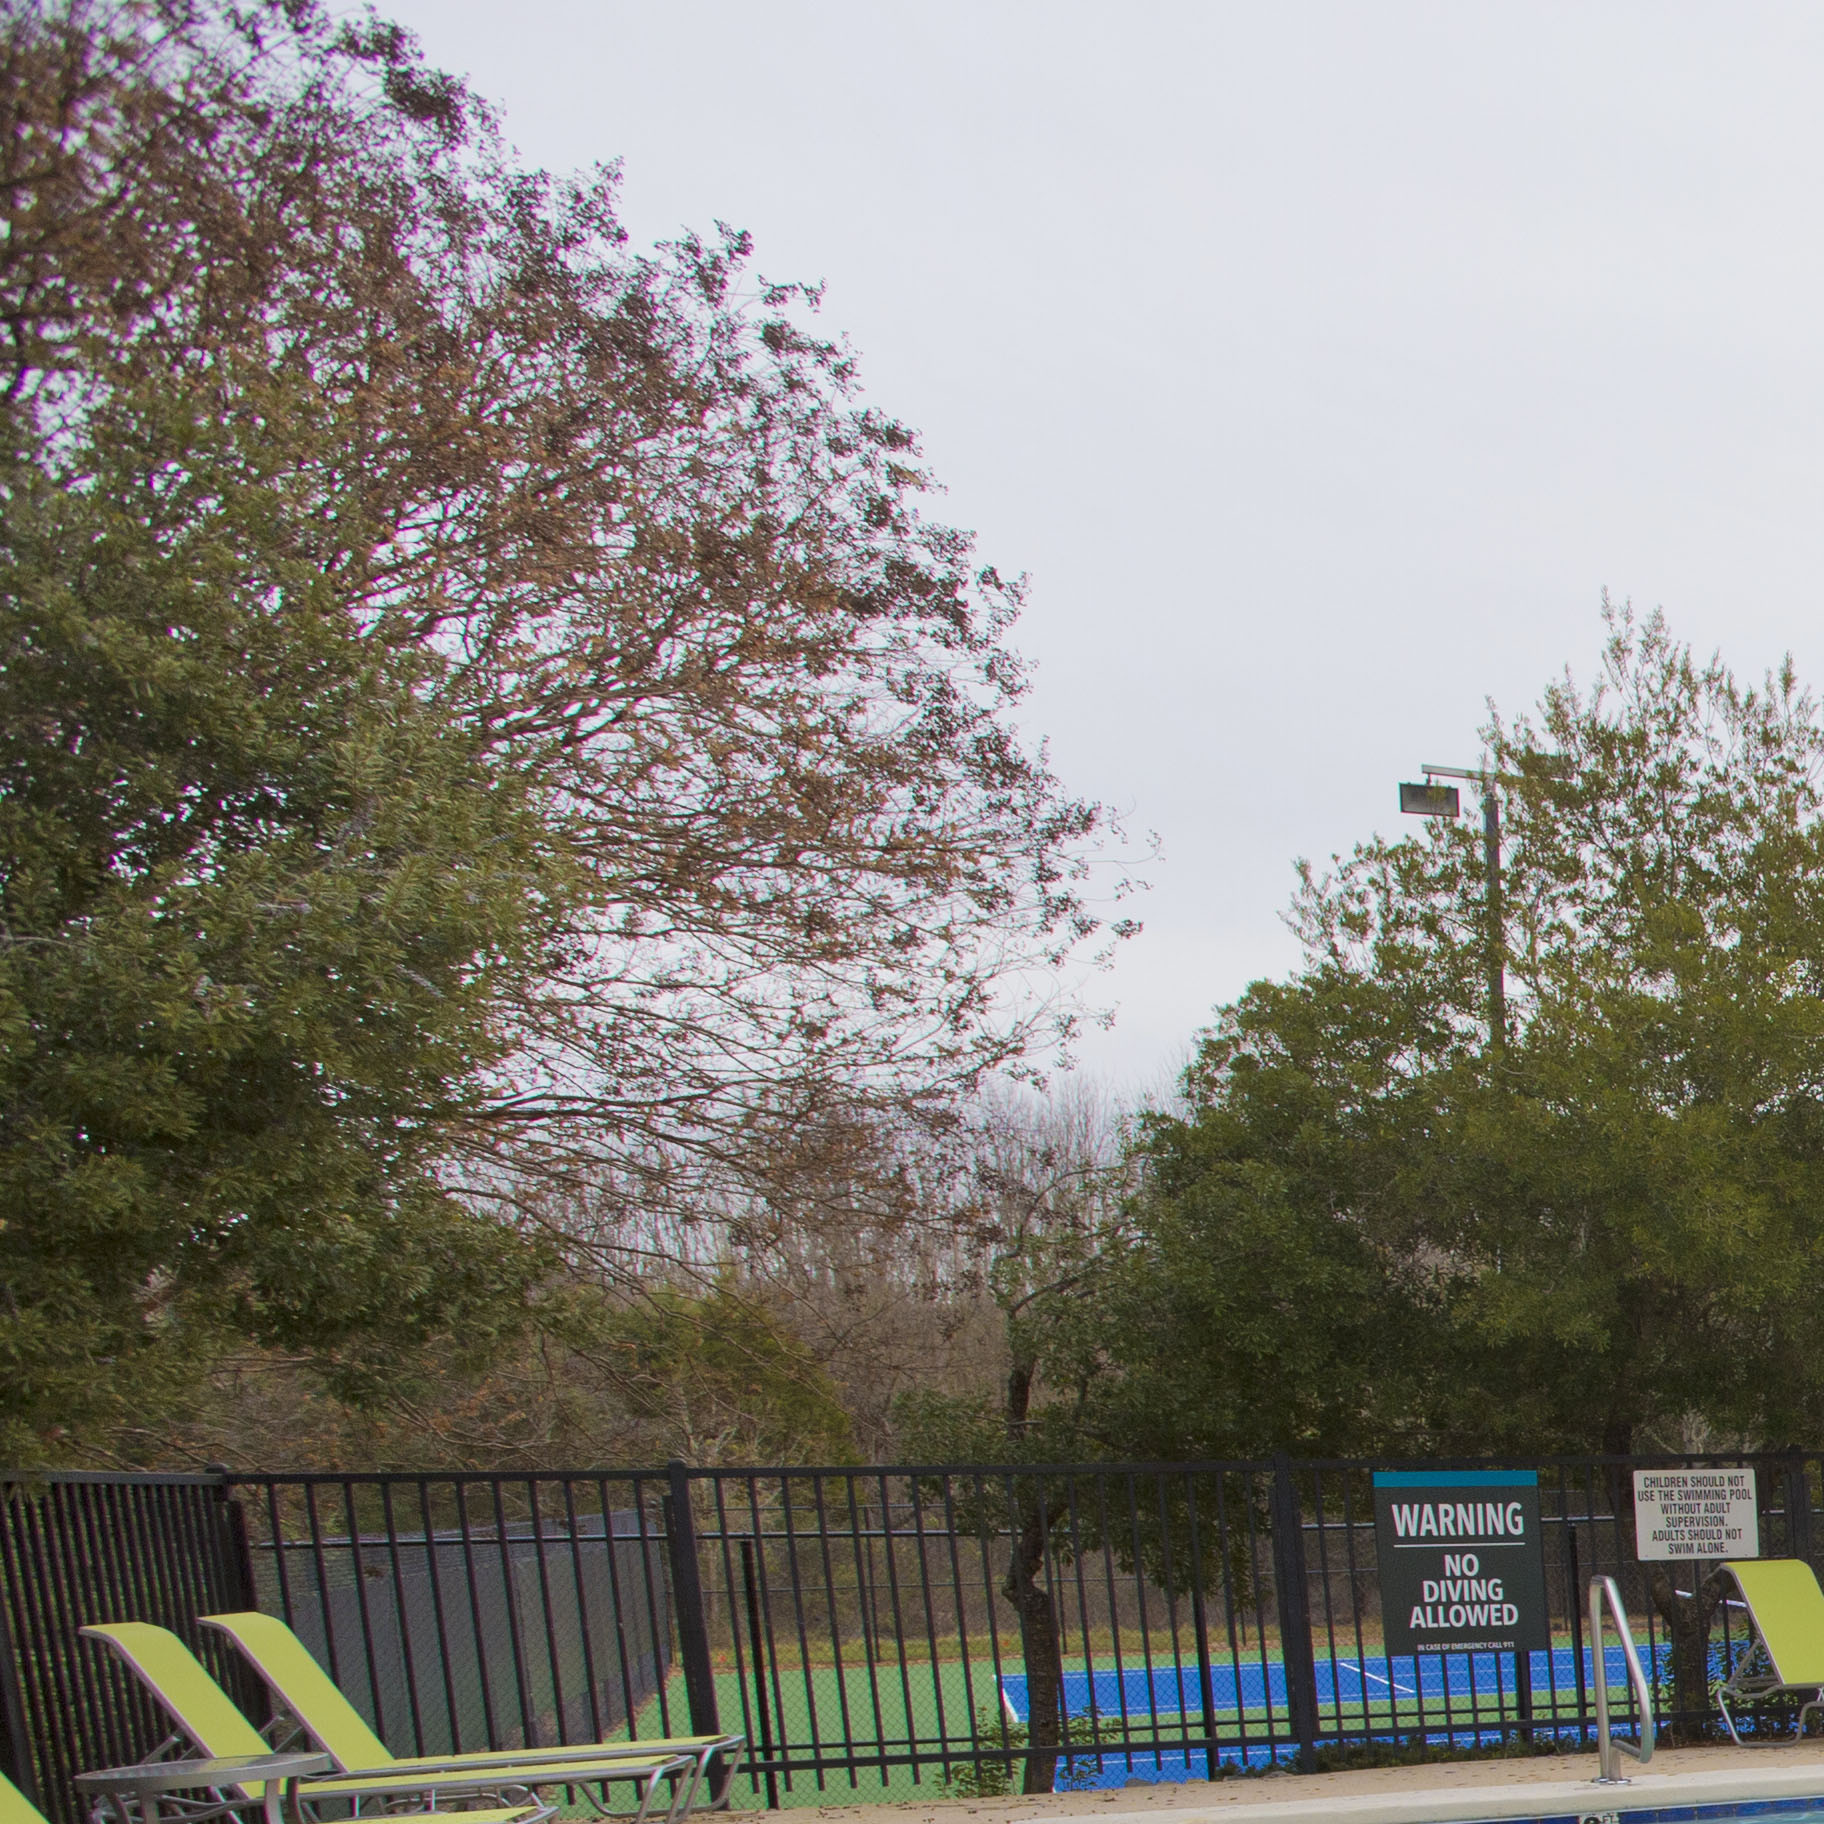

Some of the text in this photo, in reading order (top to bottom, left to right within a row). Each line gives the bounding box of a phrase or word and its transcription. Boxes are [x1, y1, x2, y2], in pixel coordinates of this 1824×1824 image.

[1643, 1475, 1745, 1489] CHILDREN SHOULD NOT
[1638, 1488, 1753, 1502] USE THE SWIMMING POOL
[1660, 1502, 1731, 1515] WITHOUT ADULT
[1391, 1502, 1525, 1537] WARNING
[1665, 1515, 1728, 1528] SUPERVISION.
[1651, 1528, 1743, 1542] ADULTS SHOULD NOT
[1668, 1542, 1729, 1555] SWIM ALONE.
[1443, 1553, 1480, 1577] NO
[1422, 1578, 1504, 1603] DIVING
[1409, 1603, 1519, 1629] ALLOWED
[1488, 1641, 1502, 1649] CALL
